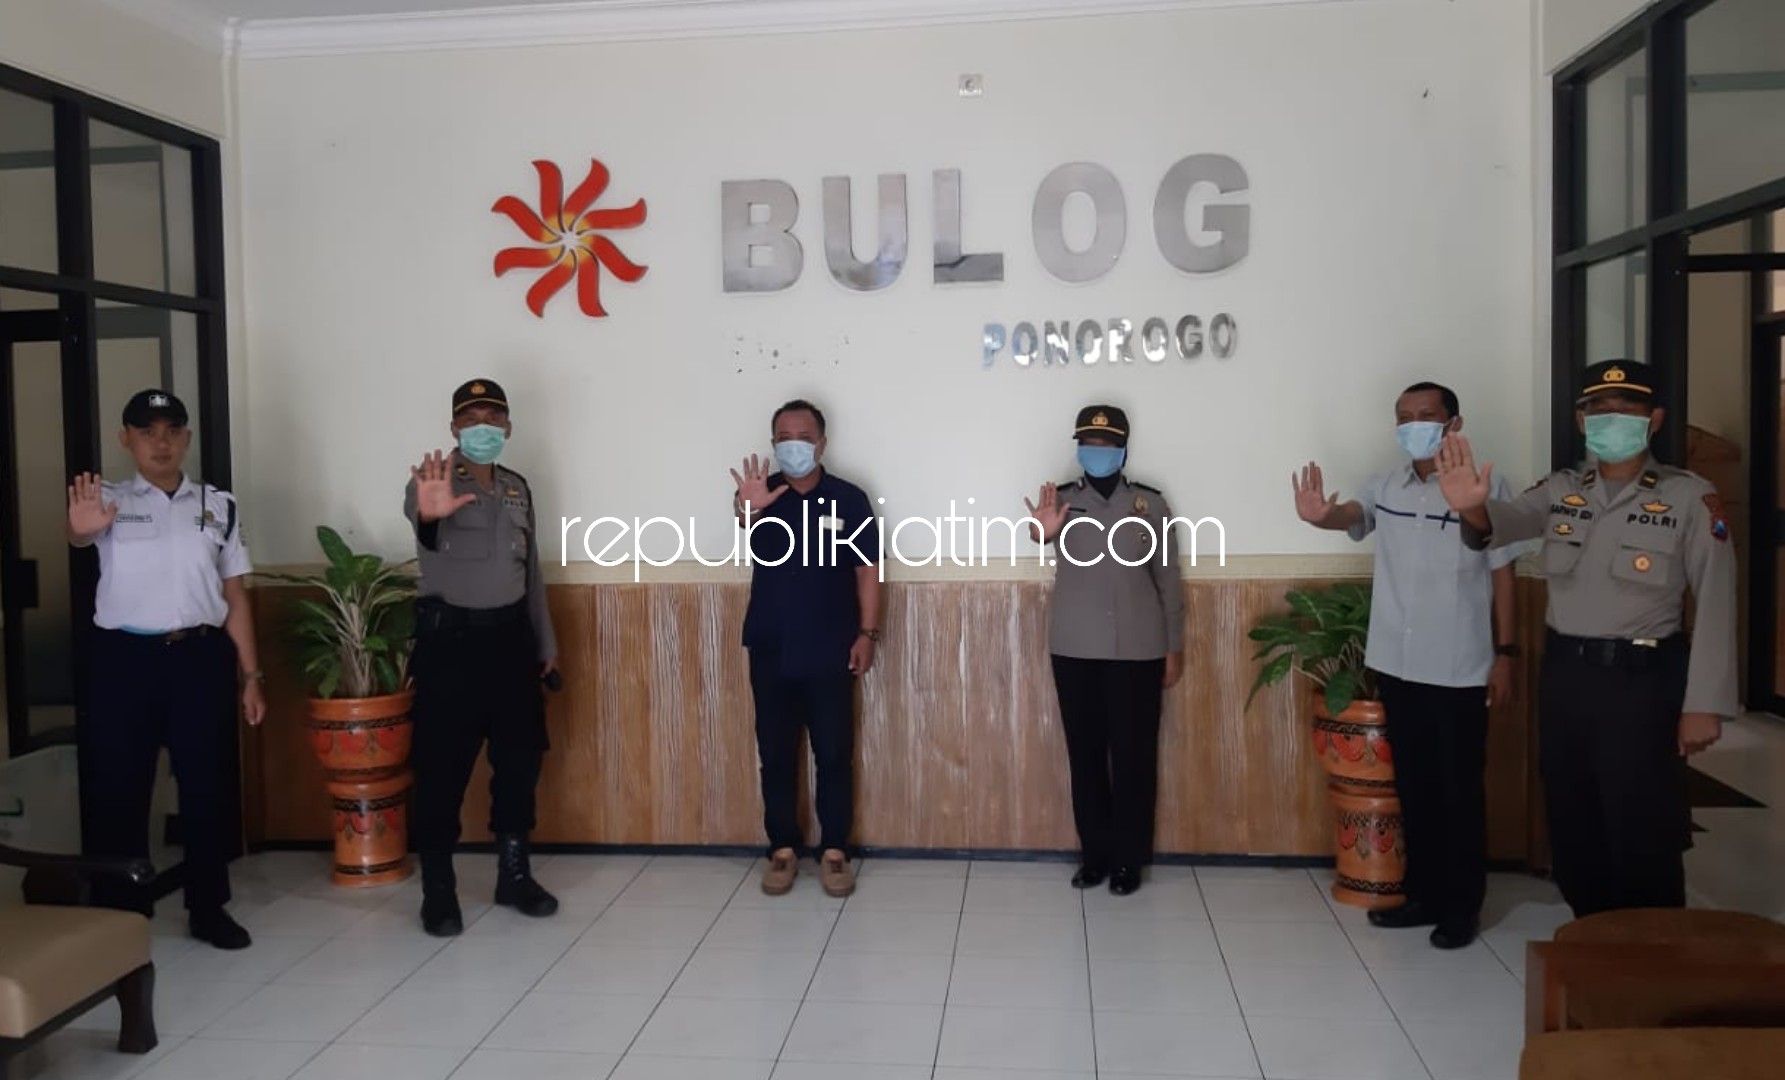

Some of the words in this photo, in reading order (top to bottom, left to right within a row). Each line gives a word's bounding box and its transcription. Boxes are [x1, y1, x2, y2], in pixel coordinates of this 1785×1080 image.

[721, 153, 1251, 293] BULOG
[981, 311, 1238, 368] PONOROGO
[1627, 513, 1677, 528] POLRI
